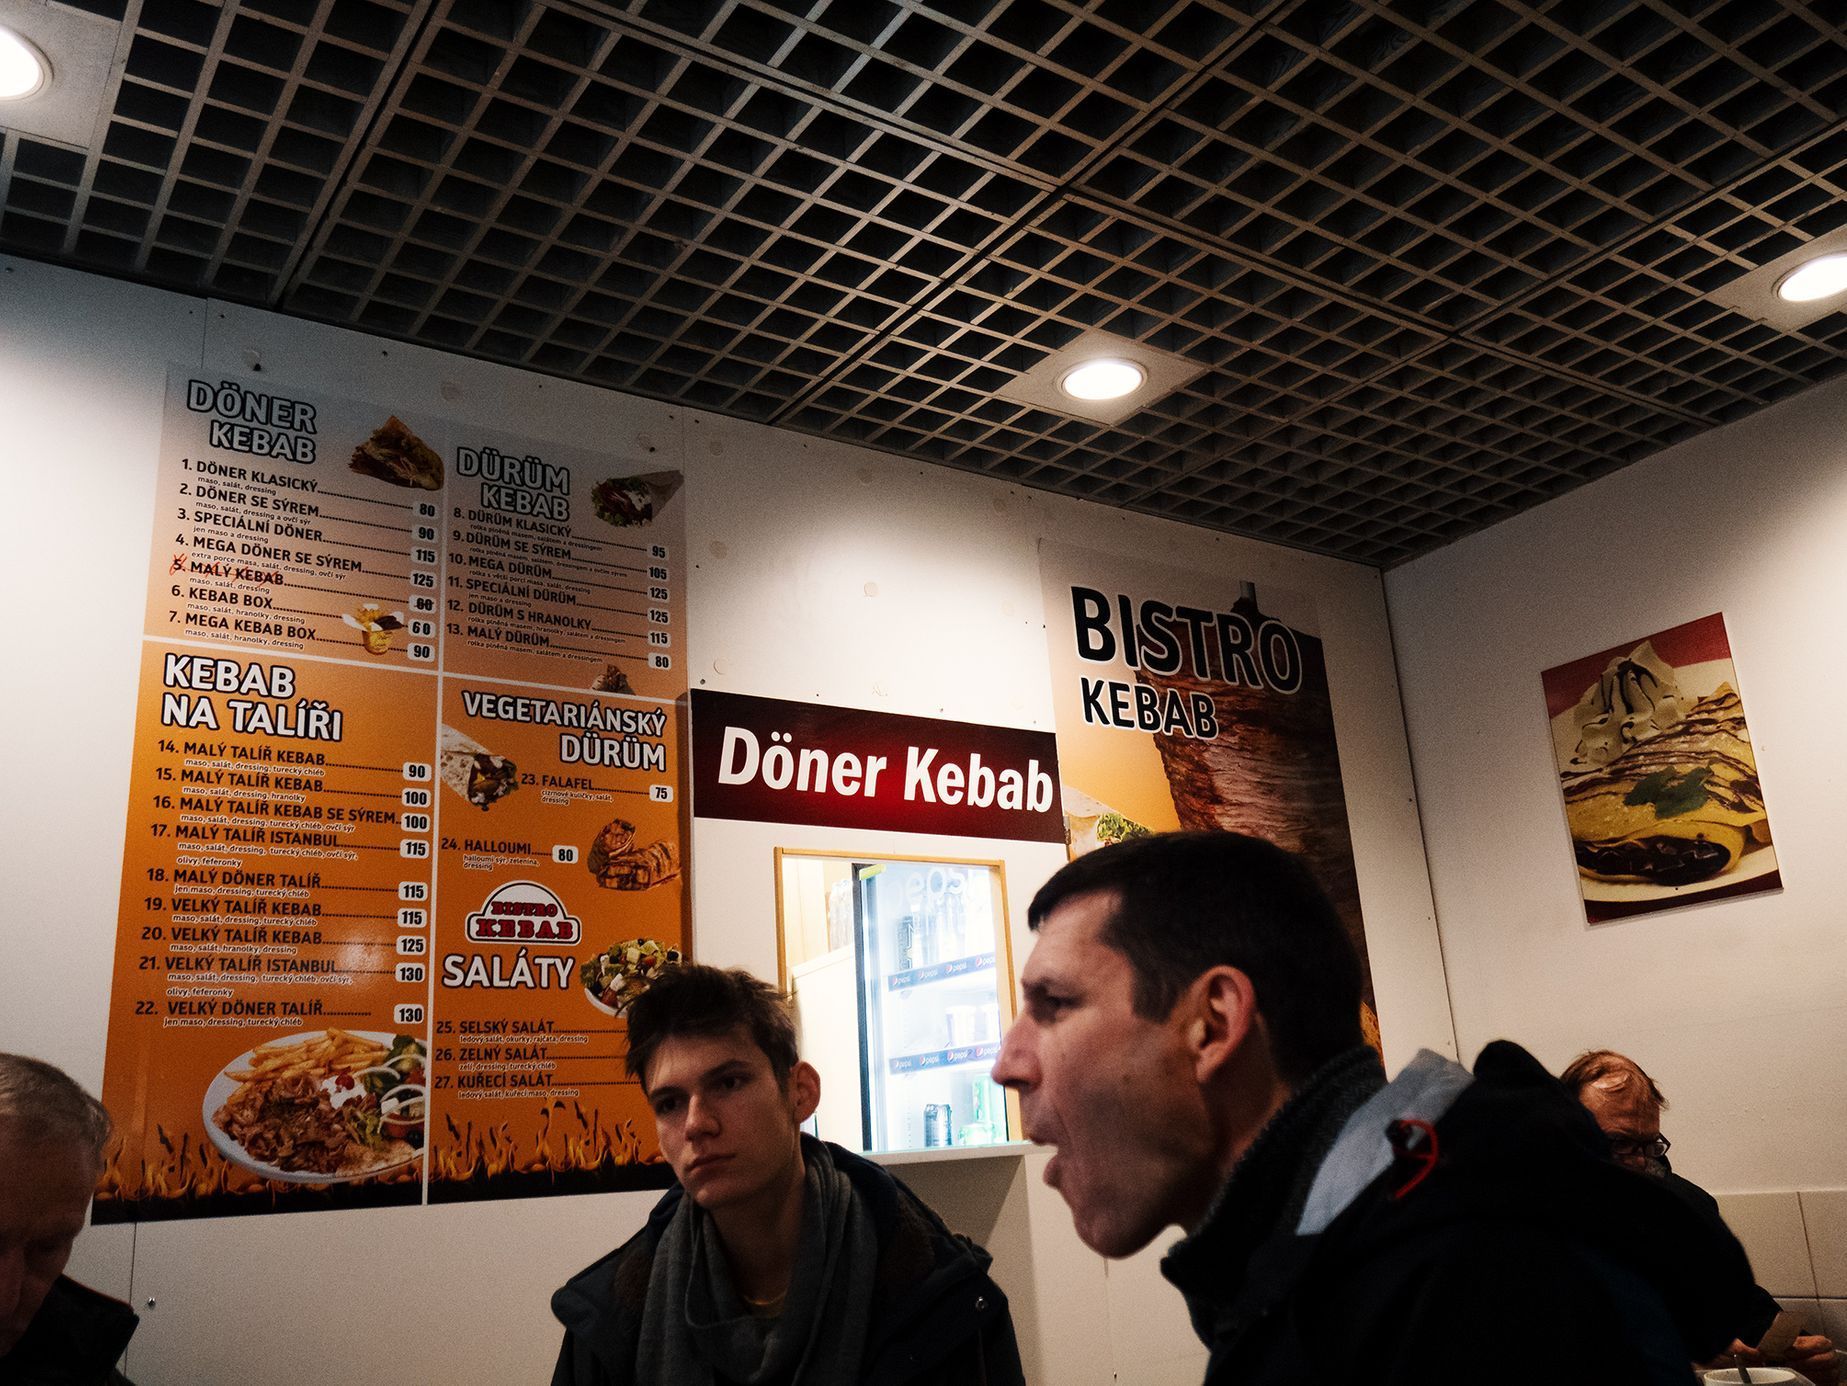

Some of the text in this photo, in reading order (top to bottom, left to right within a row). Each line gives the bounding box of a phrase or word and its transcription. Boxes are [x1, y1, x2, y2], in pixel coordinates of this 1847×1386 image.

[187, 379, 317, 434] DÖNER
[210, 421, 316, 464] KEBAB
[182, 459, 435, 517] 1. DÖNER KLASICKÝ 80
[457, 447, 570, 496] DÜRÜM
[180, 484, 434, 540] 2. DÖNER SE SÝREM 90
[481, 482, 569, 522] KEBAB
[177, 508, 435, 563] 3. SPECIÁLNÍ DÖNER 115
[453, 530, 464, 542] 9.
[466, 532, 511, 550] DÜRÜM
[514, 542, 528, 553] SE
[532, 542, 571, 560] SÝREM
[649, 568, 667, 580] 105
[454, 508, 665, 558] 8. DÜRÜM KLASICKÝ 95
[176, 534, 433, 587] 4. MEGA DÖNER SE SÝREM 125
[171, 585, 430, 635] 6. KEBAB BOX 60
[448, 576, 668, 623] 11. SPECIÁLNÍ DÜRÜM 125
[169, 611, 429, 658] 7. MEGA KEBAB BOX 90
[1071, 586, 1302, 695] BISTRO
[164, 652, 295, 699] KEBAB
[161, 693, 342, 741] NA TALÍŘI
[461, 690, 666, 738] VEGETARIÁNSKÝ
[1080, 677, 1218, 740] KEBAB
[158, 740, 426, 778] 14. MALÝ TALÍŘ KEBAB 90
[560, 732, 666, 772] DÜRÜM
[718, 726, 1053, 813] Döner Kebab
[156, 768, 426, 804] 15. MALÝ TALÍŘ KEBAB 100
[521, 774, 667, 799] 23. FALAFEL 75
[154, 796, 427, 829] 16. MALÝ TALÍŘ KEBAB SE SÝREM 100
[151, 824, 426, 855] 17. MALÝ TALÍŘ ISTANBUL 115
[441, 838, 573, 861] 24. HALLOUMI 80
[147, 869, 424, 898] 18. MALÝ DÖNER TALÍŘ 115
[476, 920, 573, 939] KEBAB
[492, 902, 557, 917] BISTRO
[442, 946, 574, 990] SALÁTY
[135, 1000, 422, 1022] 22. VELKÝ DÖNER TALÍŘ 130
[437, 1019, 554, 1034] 25. SELSKÝ SALÁT
[435, 1046, 547, 1061] 26. ZELNÝ SALÁT
[434, 1074, 552, 1088] 27. KUŘECÍ SALÁT
